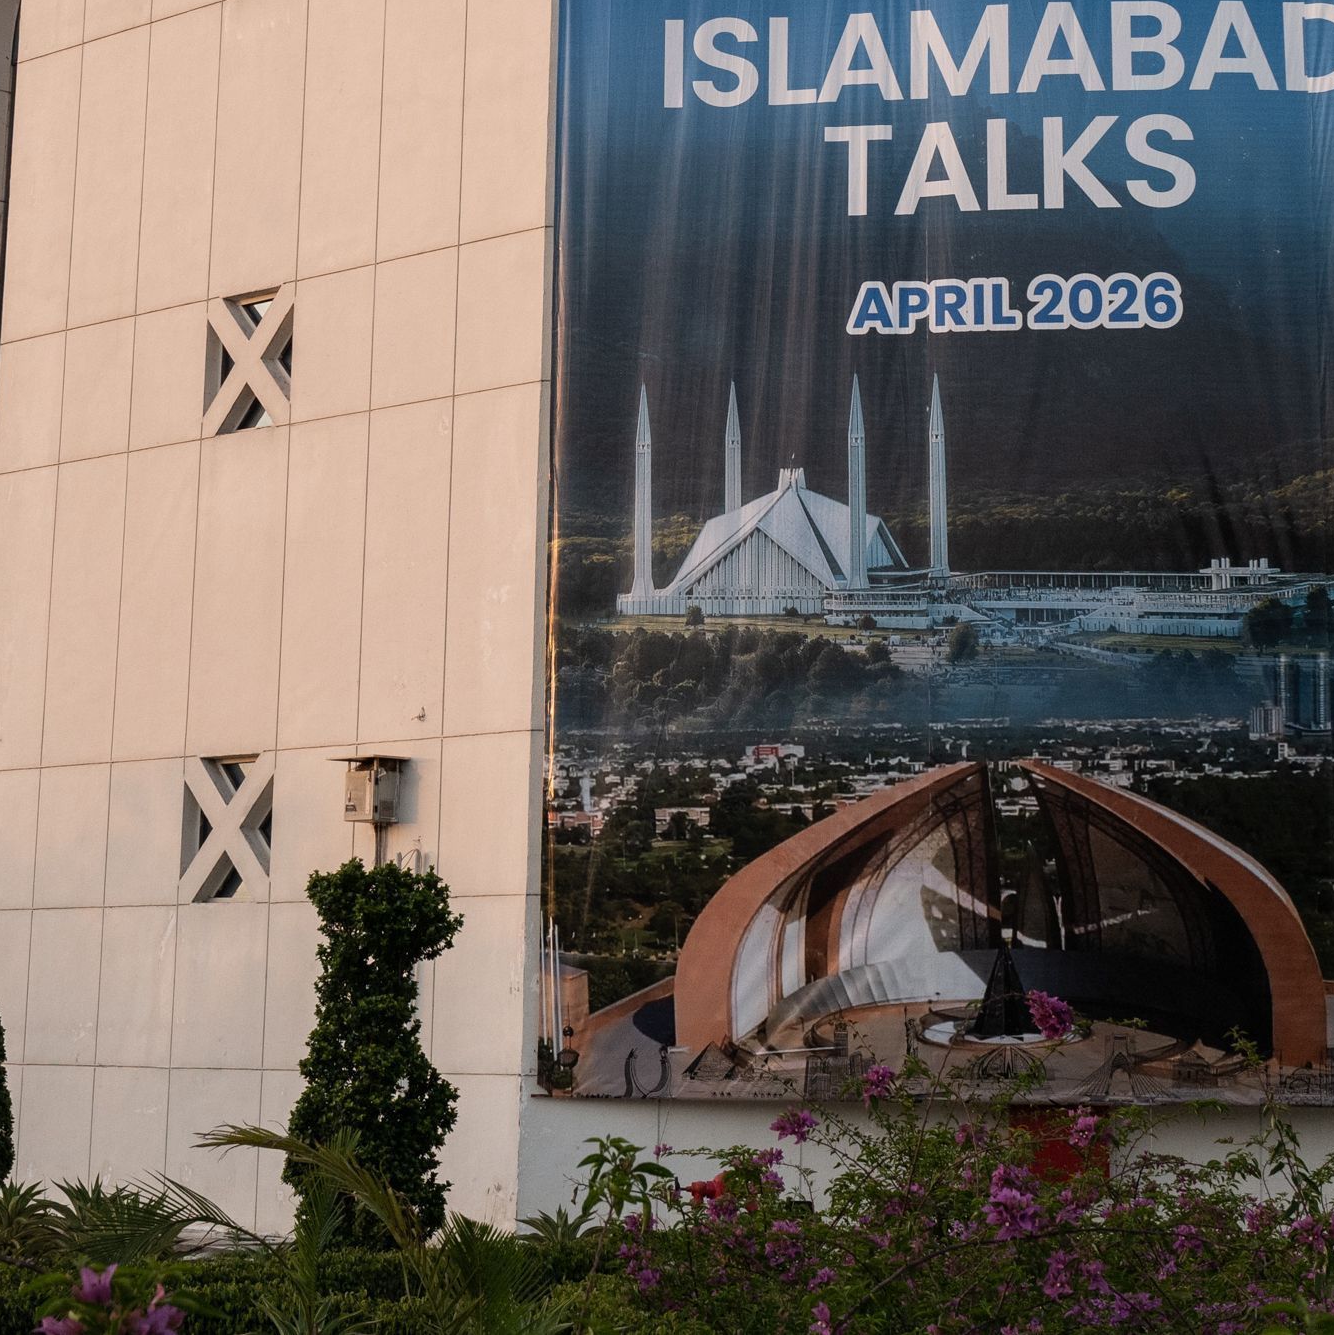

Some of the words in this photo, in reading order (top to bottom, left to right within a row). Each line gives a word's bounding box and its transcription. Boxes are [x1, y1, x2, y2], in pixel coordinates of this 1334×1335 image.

[824, 113, 1197, 217] TALKS
[846, 277, 1023, 335] APRIL
[1026, 271, 1184, 330] 2026
